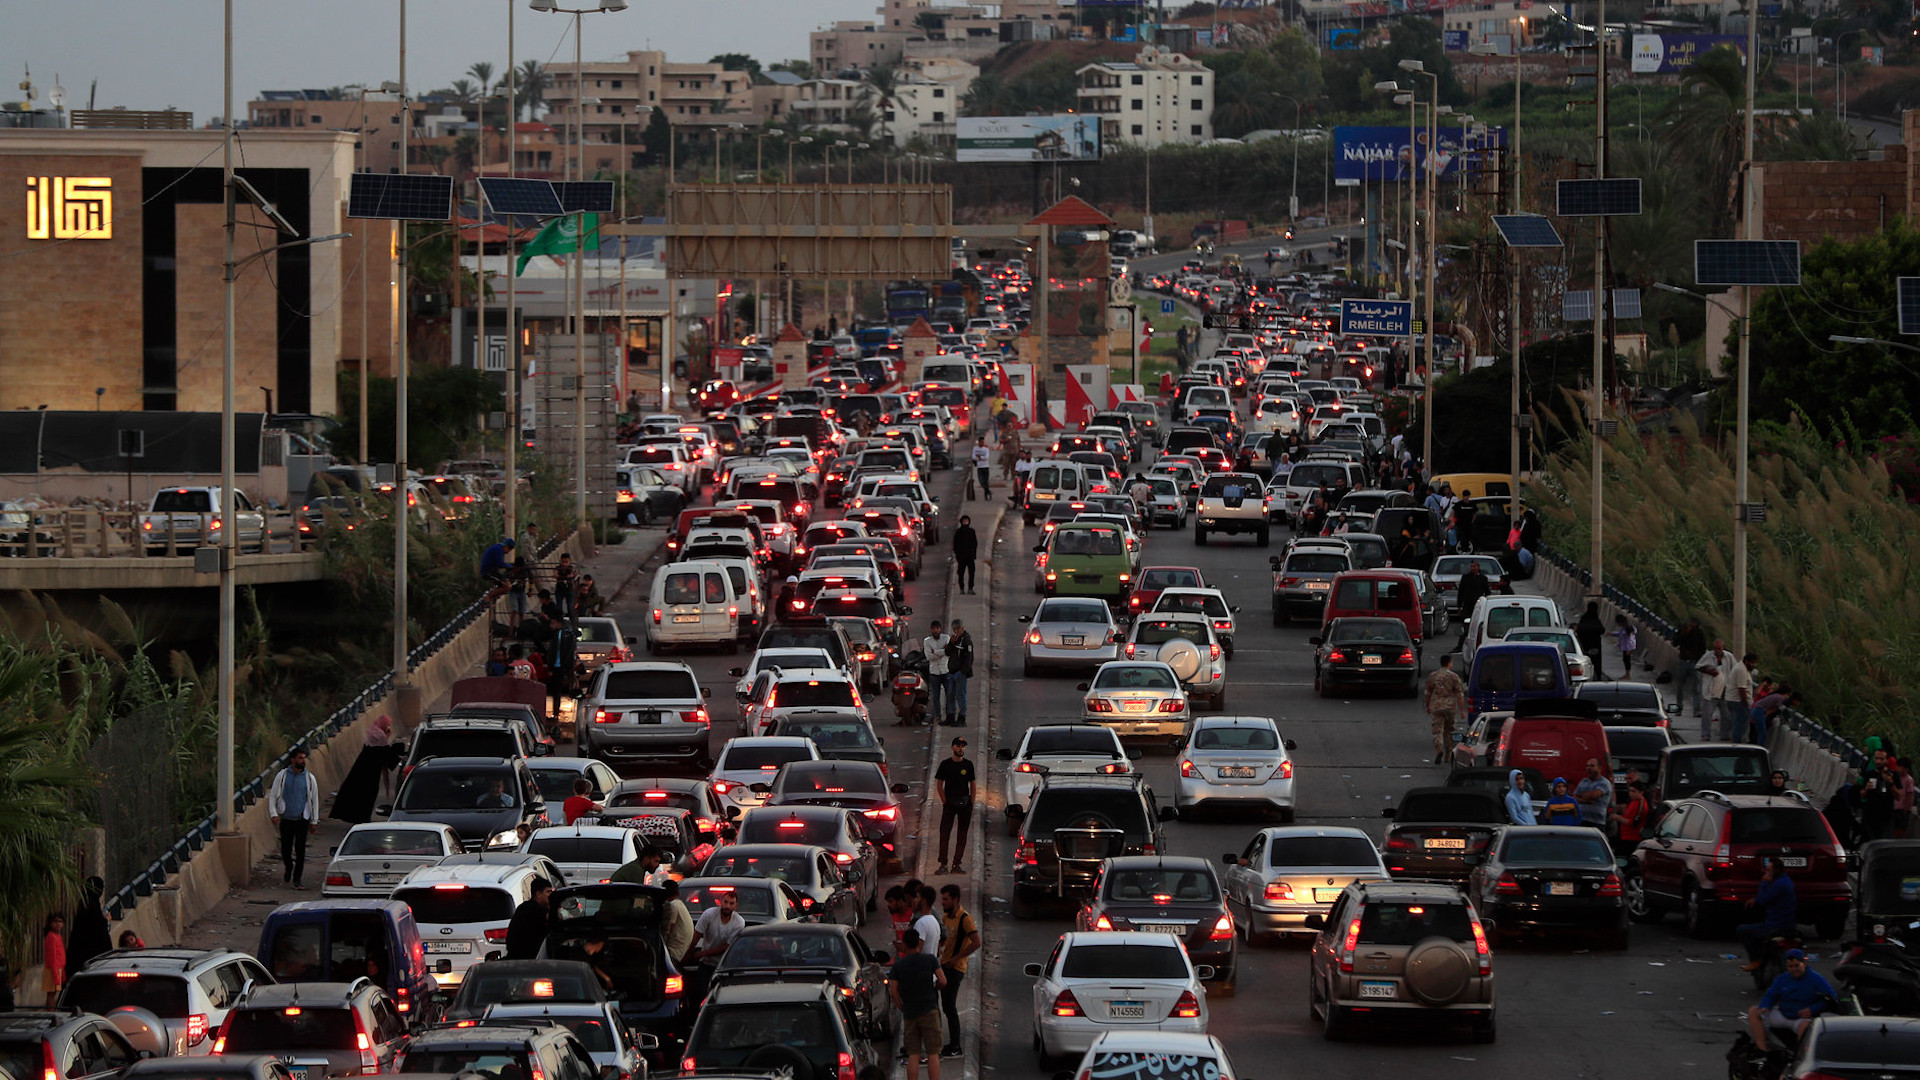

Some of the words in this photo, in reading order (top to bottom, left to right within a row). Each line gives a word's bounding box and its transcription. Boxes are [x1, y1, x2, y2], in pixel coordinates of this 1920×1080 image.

[1344, 148, 1394, 162] NAJJAR
[1349, 302, 1403, 318] الرميلة
[1348, 320, 1404, 331] RMEILEH
[1362, 986, 1394, 995] S195147
[1110, 1007, 1144, 1016] N145560
